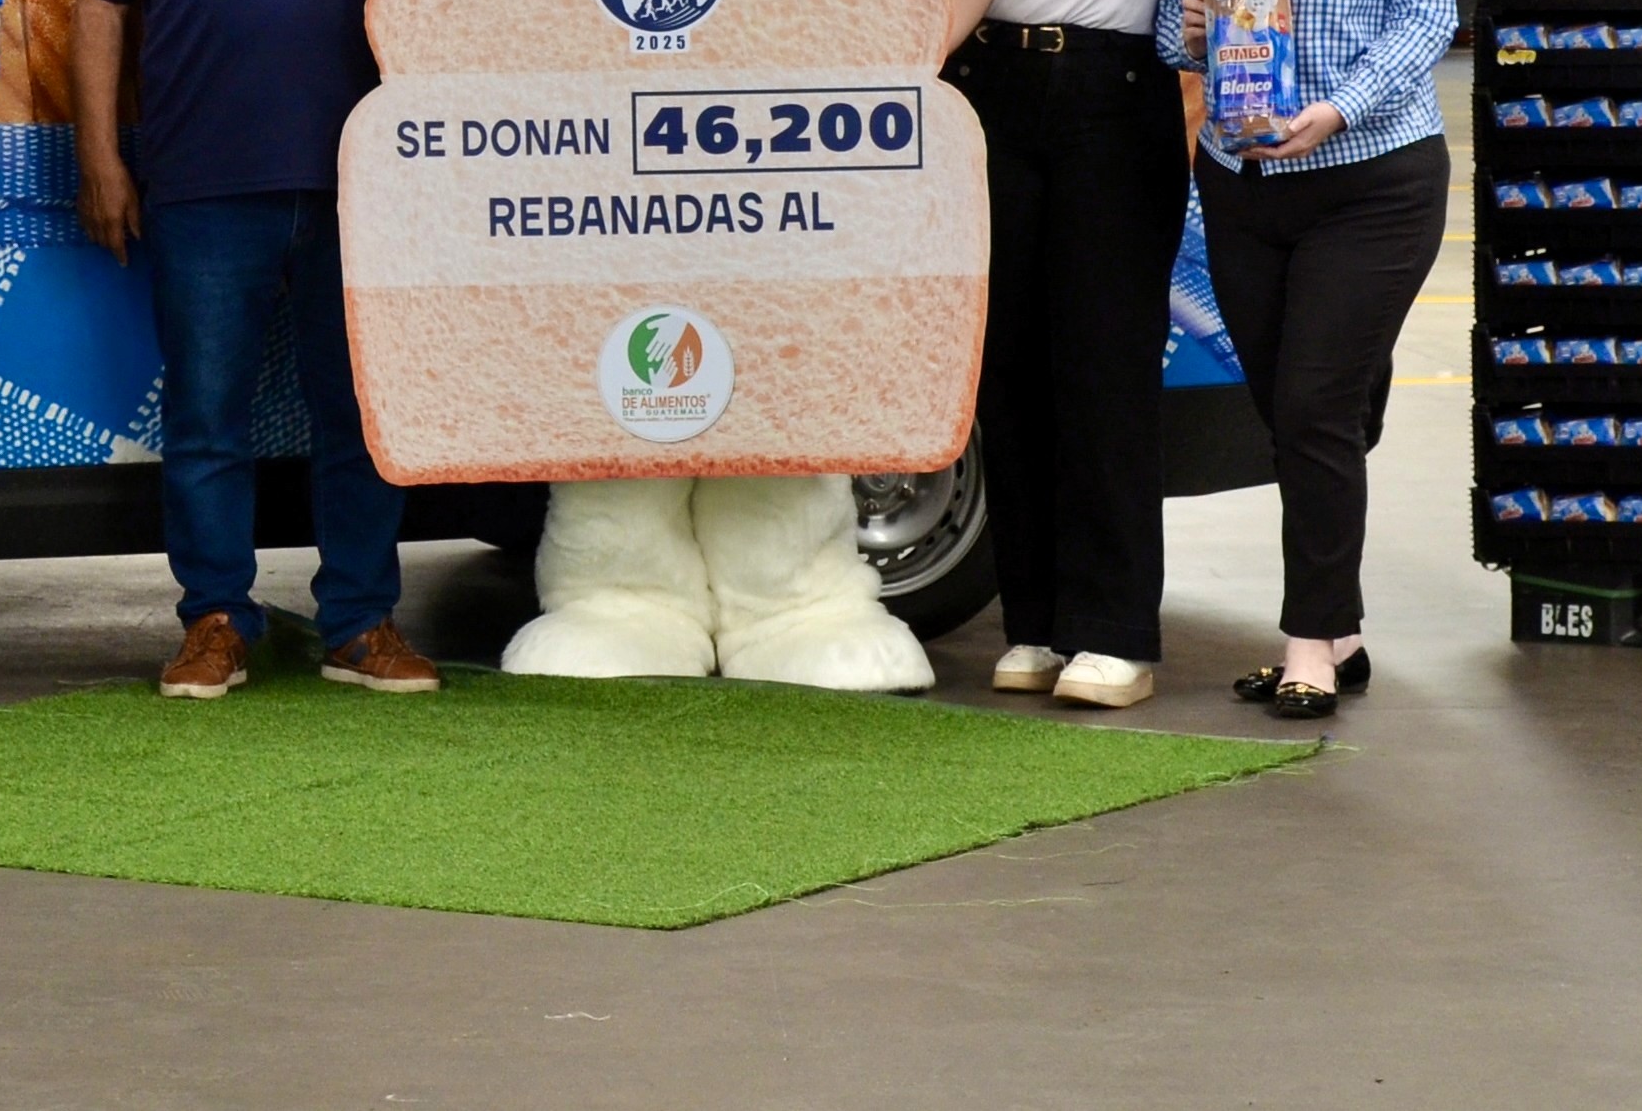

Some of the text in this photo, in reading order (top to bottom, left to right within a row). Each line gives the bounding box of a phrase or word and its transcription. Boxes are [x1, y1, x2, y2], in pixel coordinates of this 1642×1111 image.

[636, 35, 686, 50] 2025
[1220, 77, 1273, 96] Blanco
[396, 101, 914, 164] SE DONAN 46,200
[489, 191, 835, 237] REBANADAS AL
[622, 386, 653, 396] banco
[622, 395, 707, 409] DE ALIMENTOS
[645, 408, 707, 416] GUATEMALA
